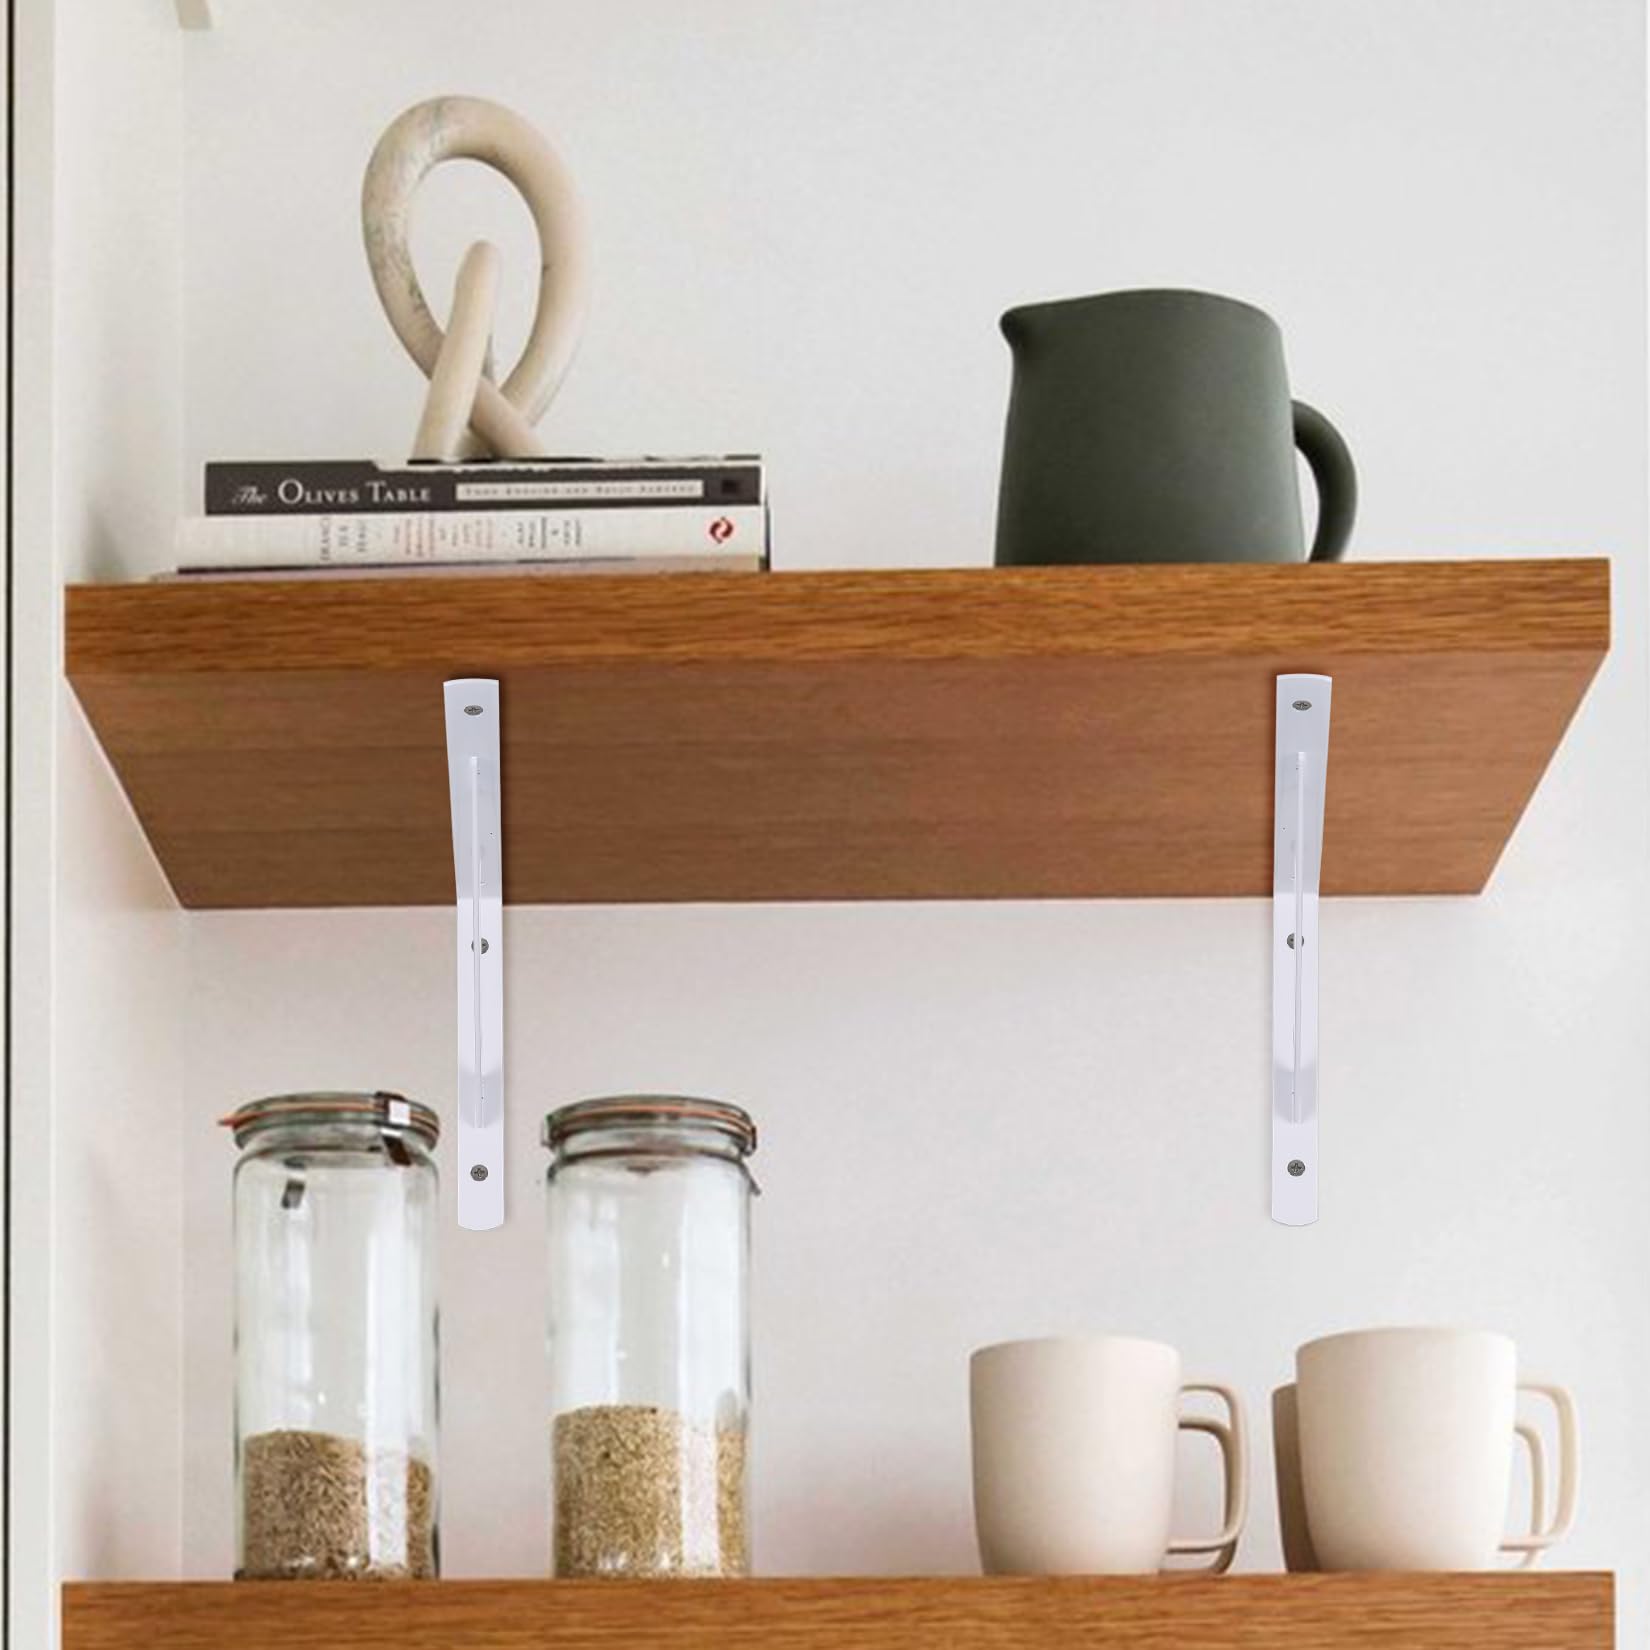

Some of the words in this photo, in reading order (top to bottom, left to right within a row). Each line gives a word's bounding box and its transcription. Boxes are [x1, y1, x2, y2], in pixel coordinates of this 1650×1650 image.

[231, 485, 268, 504] The
[277, 478, 360, 504] OLIVES
[365, 480, 431, 503] TABLE
